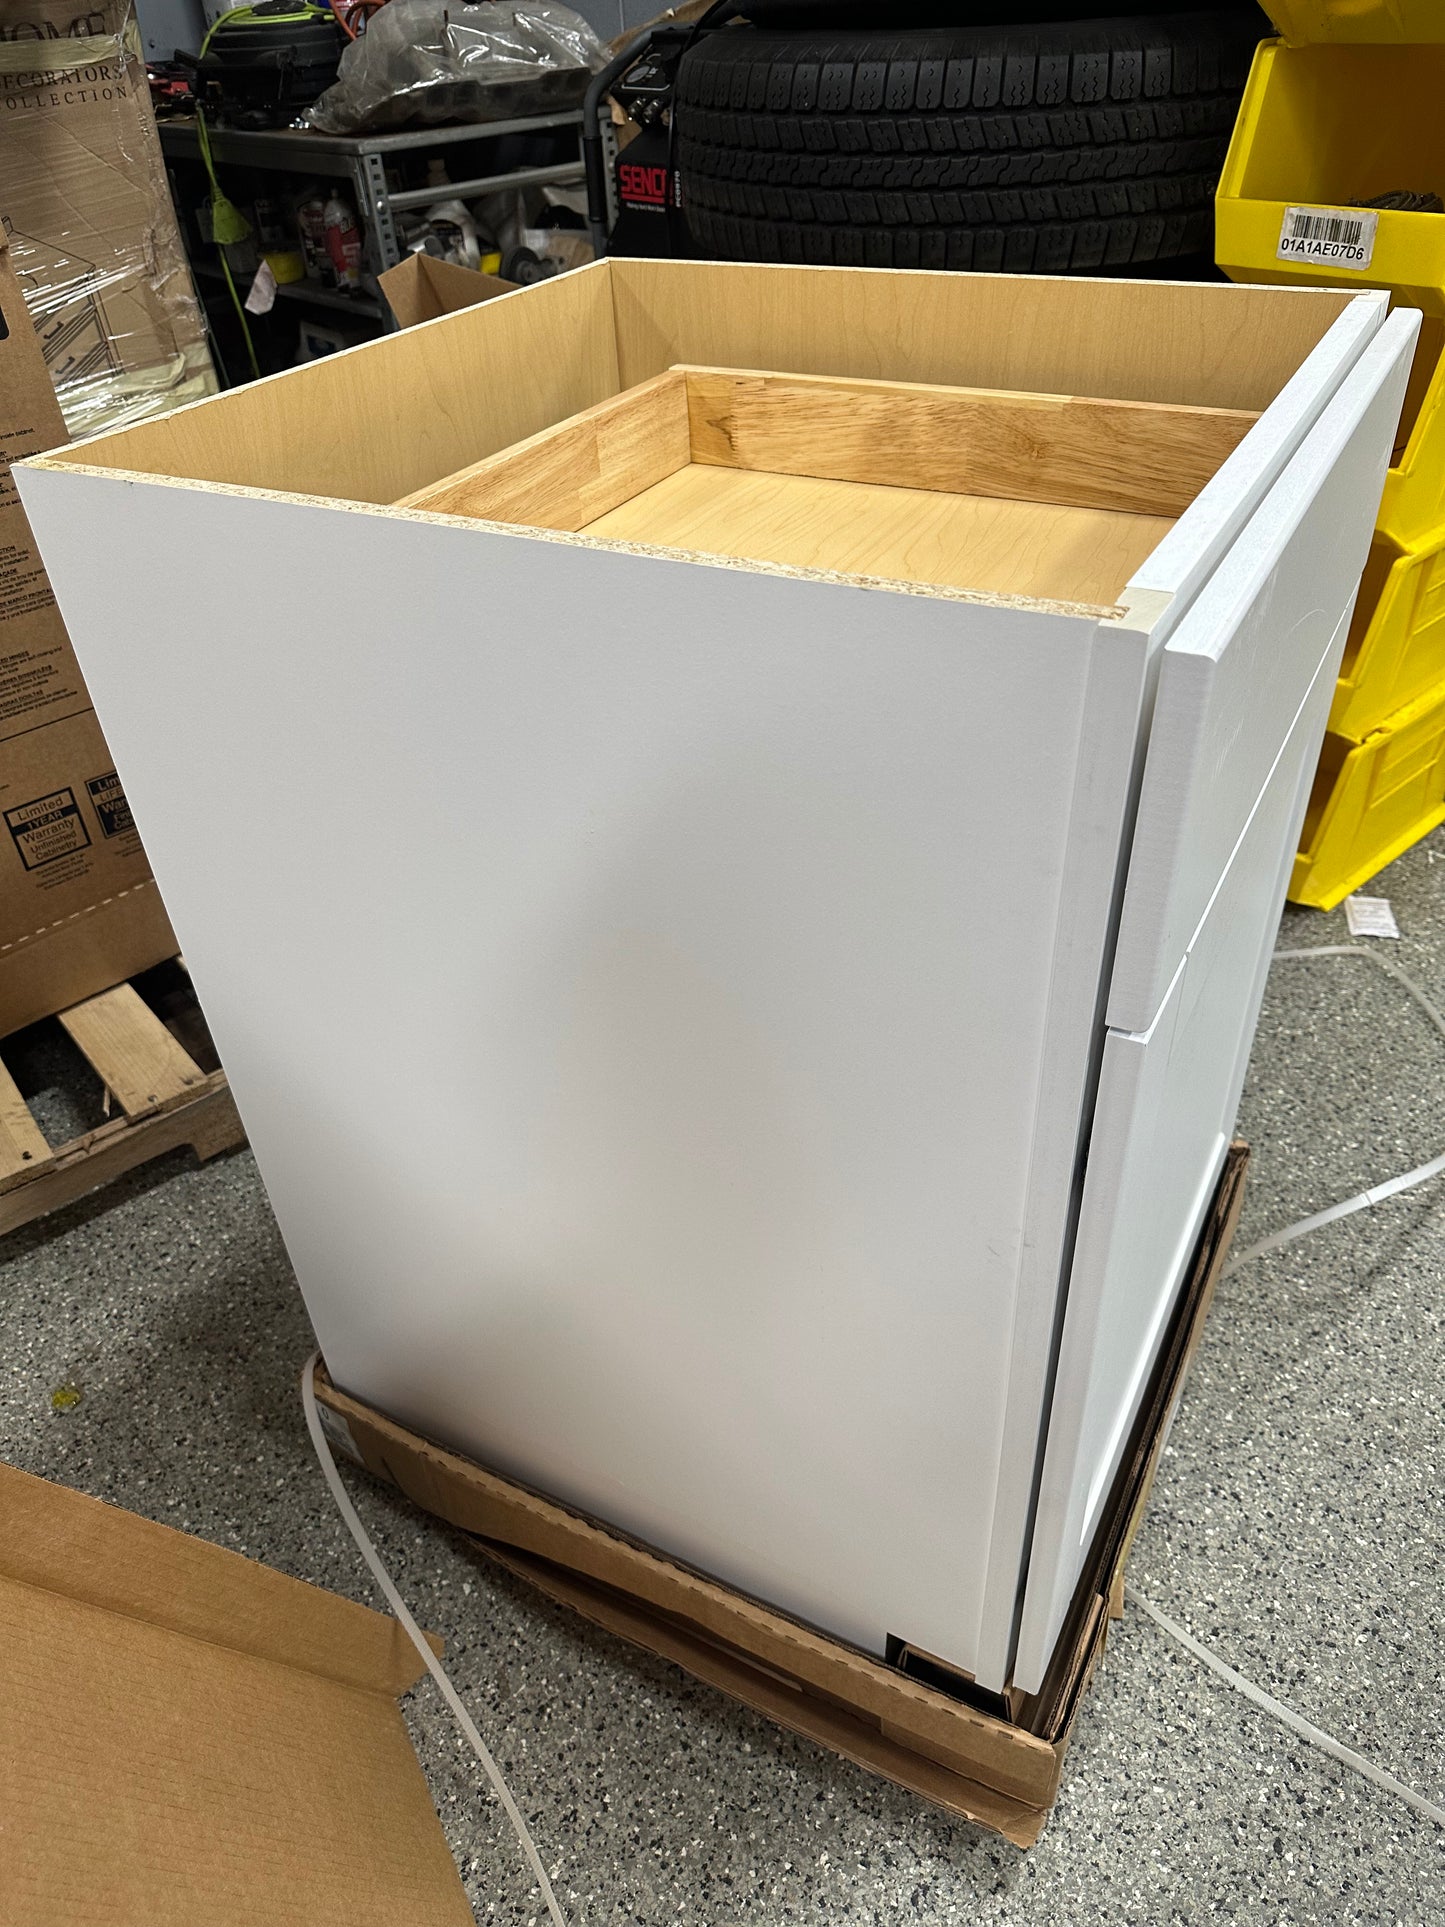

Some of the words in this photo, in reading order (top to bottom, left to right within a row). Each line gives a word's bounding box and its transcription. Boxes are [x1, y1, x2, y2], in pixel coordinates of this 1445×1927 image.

[0, 13, 107, 40] OME
[2, 64, 124, 89] ECORATORS
[0, 86, 127, 110] OLLECTION
[1281, 238, 1365, 260] 01A1AE07D6
[17, 796, 64, 821] Limited
[22, 817, 75, 844] Warranty
[30, 830, 77, 853] Unfinished
[35, 839, 77, 861] Cabinetry
